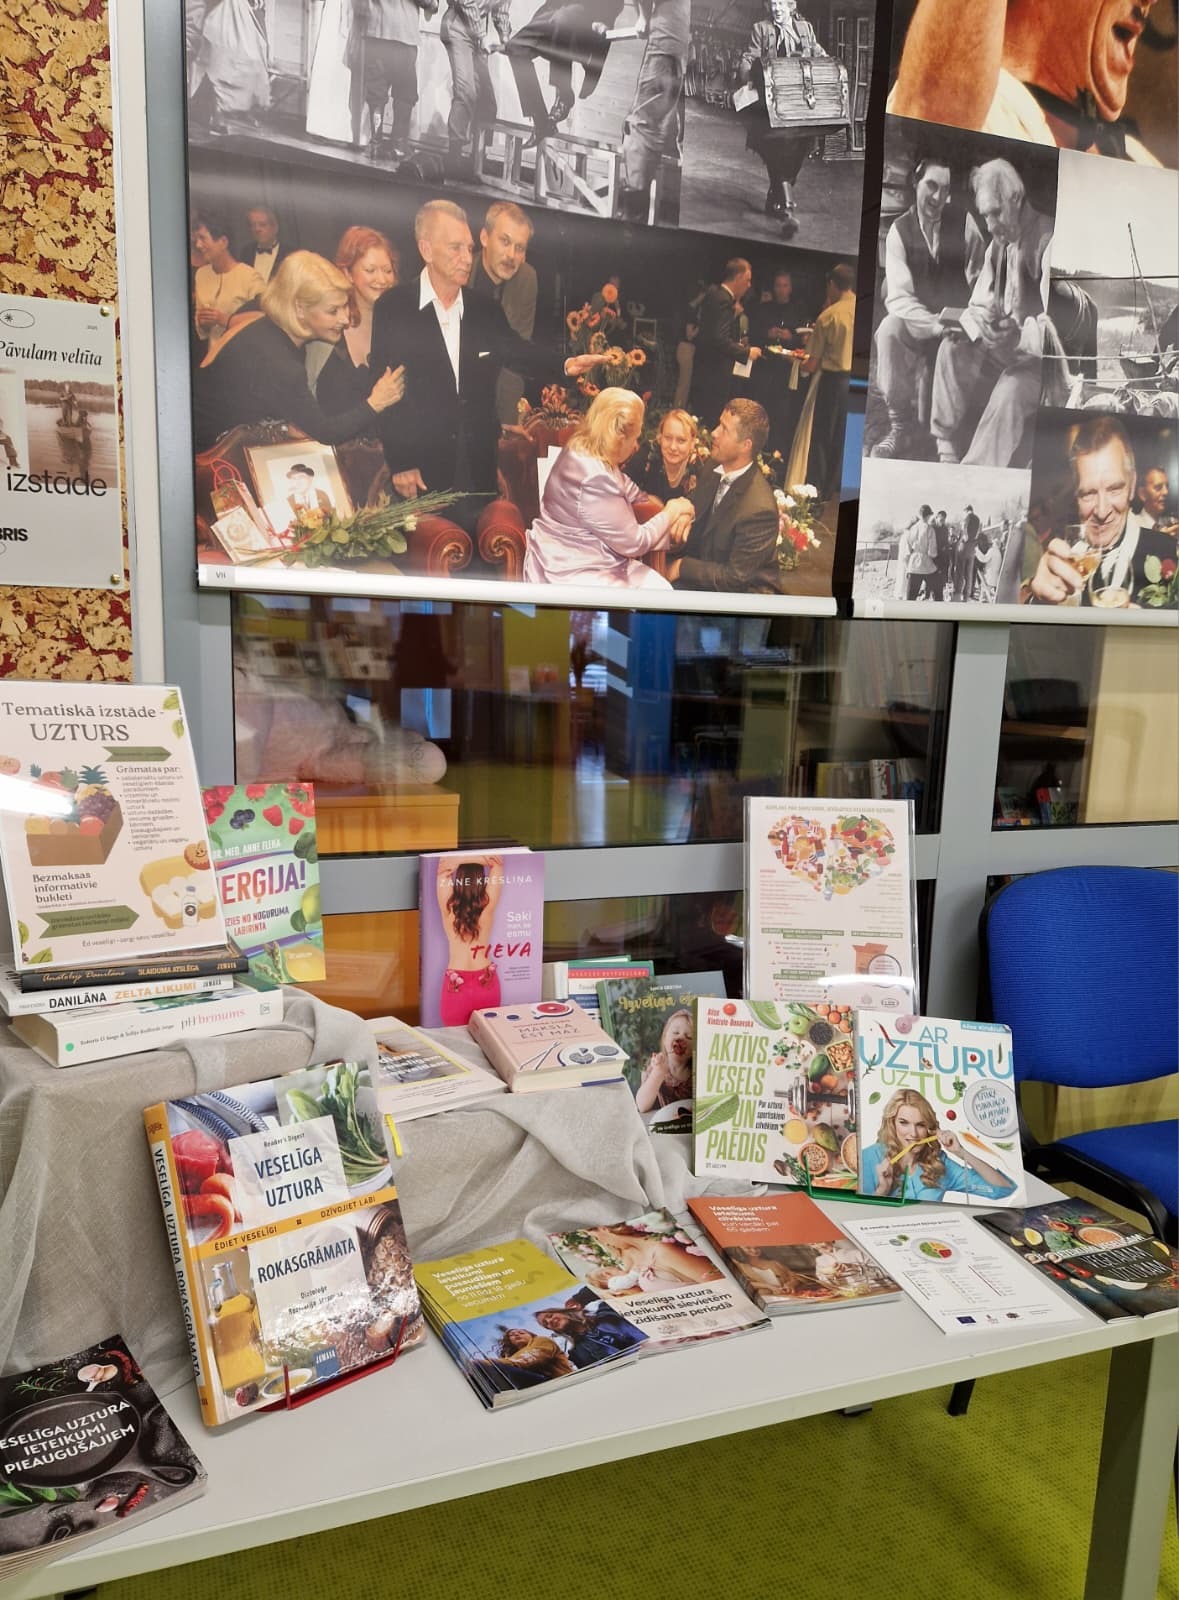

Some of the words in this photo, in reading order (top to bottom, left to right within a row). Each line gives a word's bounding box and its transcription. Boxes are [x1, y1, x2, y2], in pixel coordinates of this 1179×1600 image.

[61, 348, 102, 366] veltīta
[7, 466, 107, 497] izstāde
[0, 527, 28, 541] RIS
[1, 702, 96, 717] Tematiskā
[99, 704, 156, 718] izstāde
[30, 723, 130, 741] UZTURS
[32, 872, 91, 883] Bezmaksas
[219, 860, 306, 905] ERĢIJA!
[439, 876, 471, 887] ZANE
[36, 892, 73, 904] bukleti
[253, 905, 289, 920] NOGURUMA
[507, 911, 531, 922] Saki
[471, 941, 532, 960] TIEVA
[49, 991, 107, 1009] DANILĀNA
[114, 986, 154, 999] ZELTA
[156, 982, 197, 995] LIKUMI
[708, 1031, 772, 1066] AKTĪVS,
[919, 1026, 949, 1044] AR
[857, 1036, 1013, 1080] UZTURU
[705, 1064, 766, 1097] VESELS
[731, 1099, 757, 1129] UN
[705, 1127, 768, 1164] PAĒDIS
[254, 1146, 323, 1179] VESELĪGA
[154, 1148, 172, 1209] VESELĪGA
[265, 1176, 324, 1208] UZTURA
[359, 1197, 376, 1208] LABI
[165, 1213, 182, 1265] UZTURA
[214, 1237, 238, 1251] ĒDIET
[241, 1226, 277, 1244] VESELĪGI
[257, 1237, 356, 1284] ROKASGRĀMATA
[676, 1288, 713, 1300] uztura
[677, 1293, 732, 1309] sievietēm
[689, 1301, 734, 1317] periodā
[176, 1270, 201, 1378] ROKASGRĀMATA
[65, 1400, 130, 1432] UZTURA
[4, 1424, 135, 1476] PIEAUGUŠAJIEM
[23, 1422, 106, 1457] IETEIKUMI
